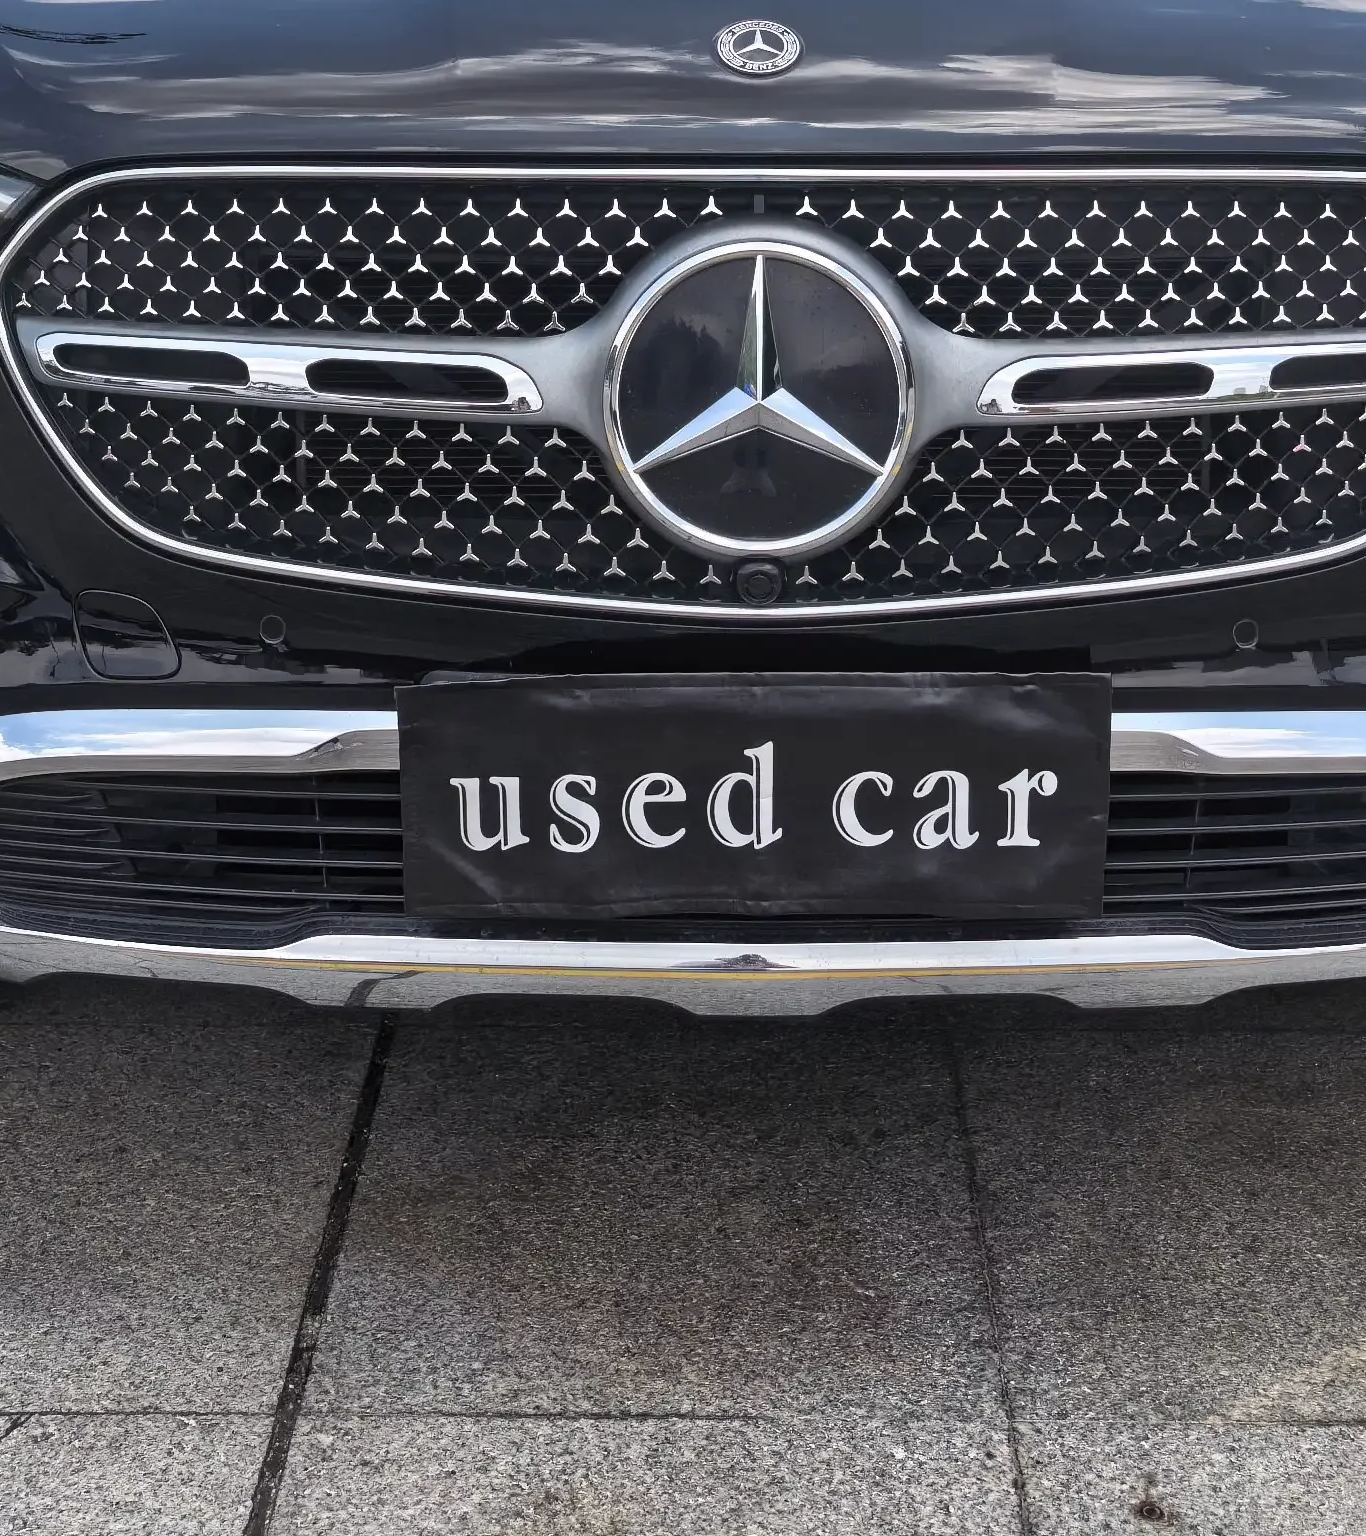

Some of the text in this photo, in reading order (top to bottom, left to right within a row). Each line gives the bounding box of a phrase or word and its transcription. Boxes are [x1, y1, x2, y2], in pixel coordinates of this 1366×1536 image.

[745, 62, 775, 71] BENZ
[449, 740, 1059, 853] used car
